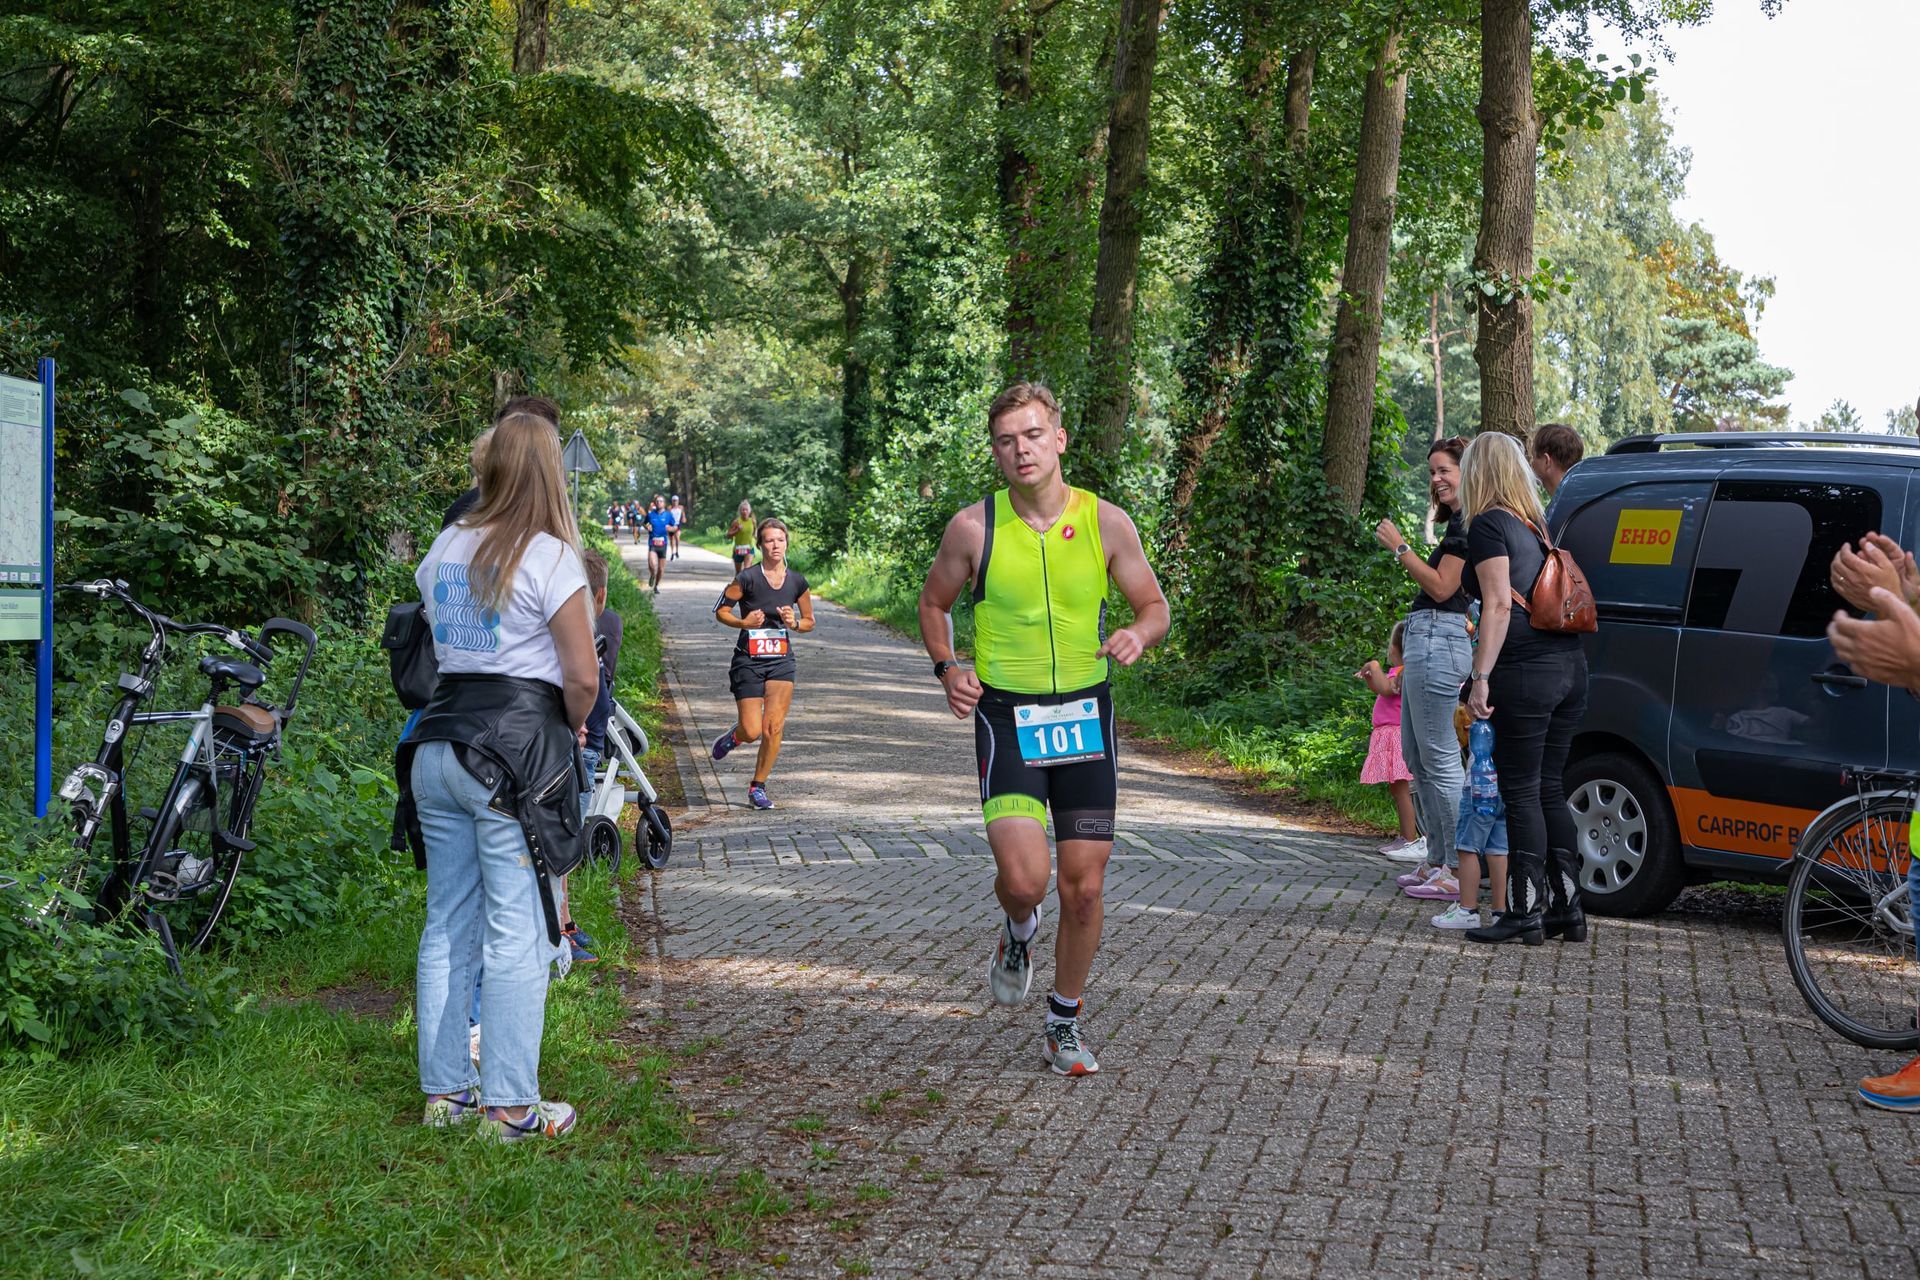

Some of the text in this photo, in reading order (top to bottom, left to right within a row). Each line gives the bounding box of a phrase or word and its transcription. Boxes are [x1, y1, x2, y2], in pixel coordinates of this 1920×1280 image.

[1618, 527, 1672, 546] EHBO
[756, 639, 782, 654] 203
[1034, 723, 1084, 755] 101
[1697, 814, 1783, 843] CARPROF
